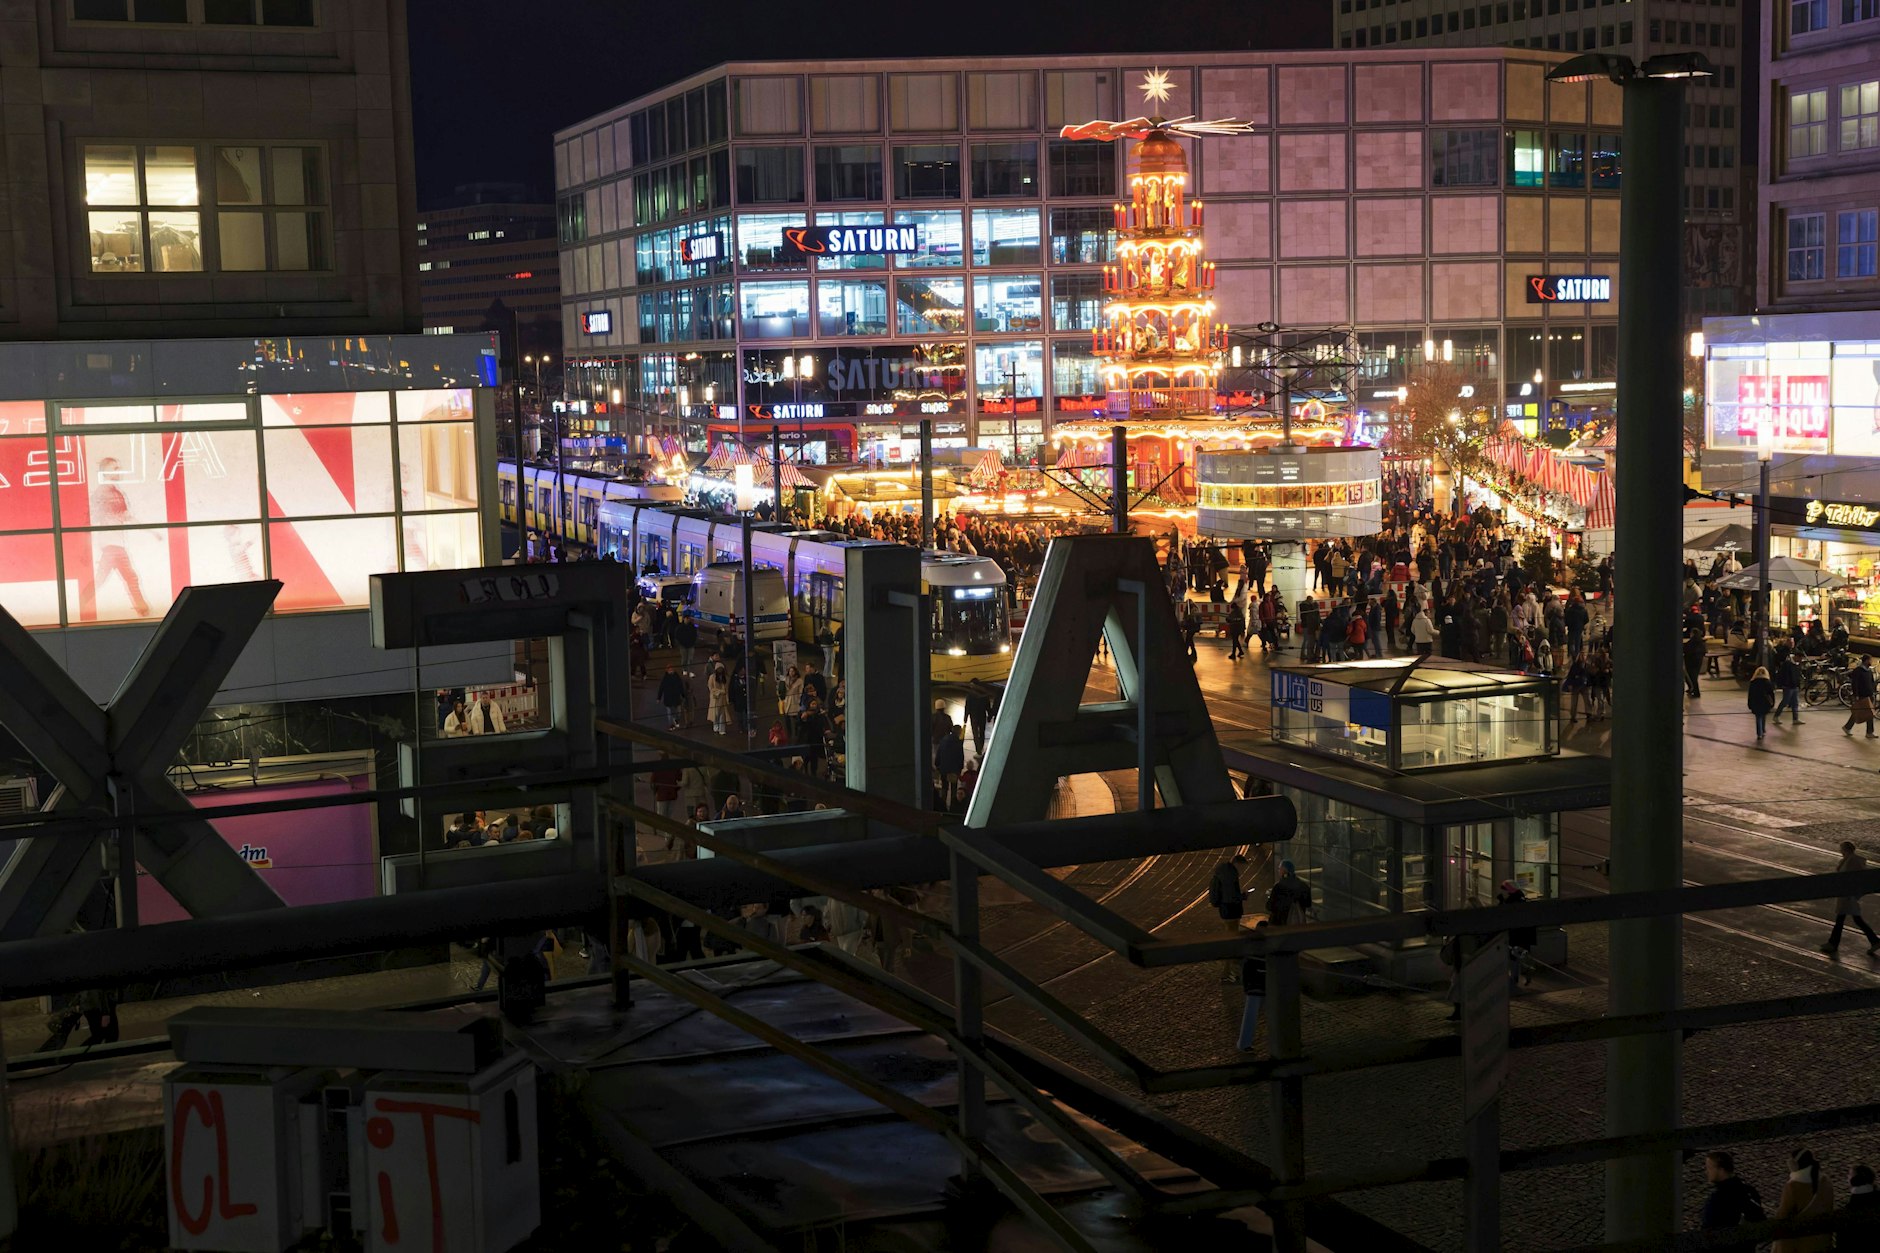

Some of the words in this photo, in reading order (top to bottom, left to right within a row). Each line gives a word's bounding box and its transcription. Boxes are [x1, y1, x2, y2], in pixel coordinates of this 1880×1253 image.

[690, 235, 717, 261] SATURN
[829, 226, 916, 253] SATURN
[1557, 278, 1610, 300] SATURN
[773, 404, 824, 419] SATURN
[866, 403, 894, 416] snipes
[920, 401, 949, 415] snipes
[1309, 487, 1325, 504] 13
[1331, 485, 1347, 502] 14
[1350, 486, 1363, 501] 15
[1825, 503, 1880, 527] Tchibo
[1274, 673, 1288, 705] U
[1311, 682, 1322, 696] U8
[1311, 698, 1322, 712] U5
